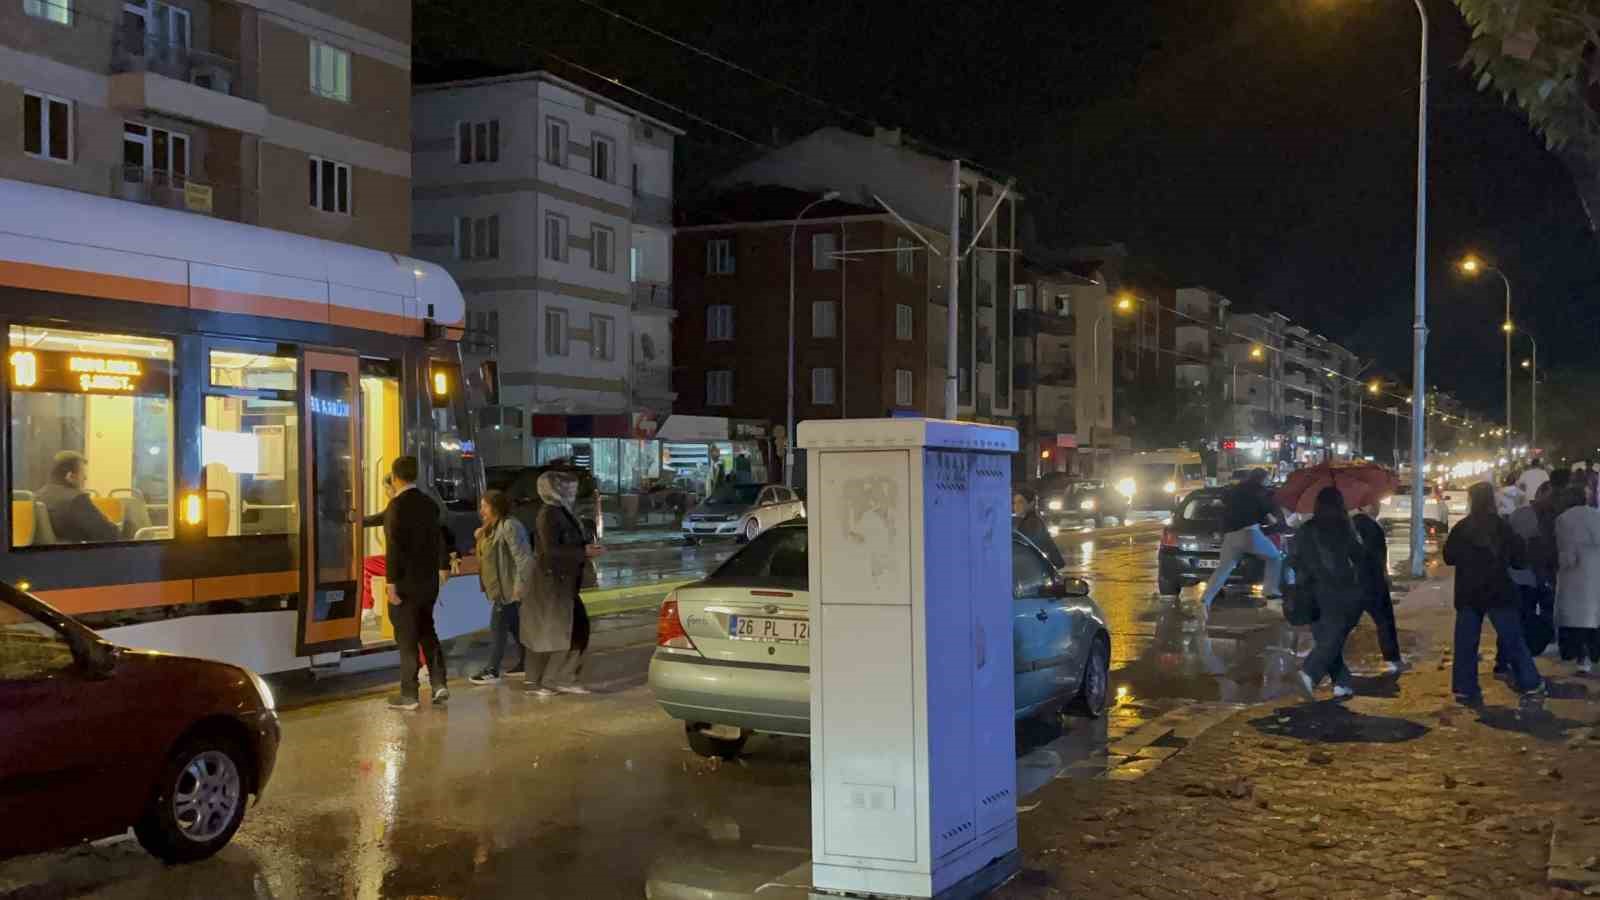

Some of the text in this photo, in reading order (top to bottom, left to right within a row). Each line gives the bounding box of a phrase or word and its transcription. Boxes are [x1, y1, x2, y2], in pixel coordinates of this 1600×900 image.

[10, 351, 37, 386] 11
[738, 619, 809, 639] 26 PL 12
